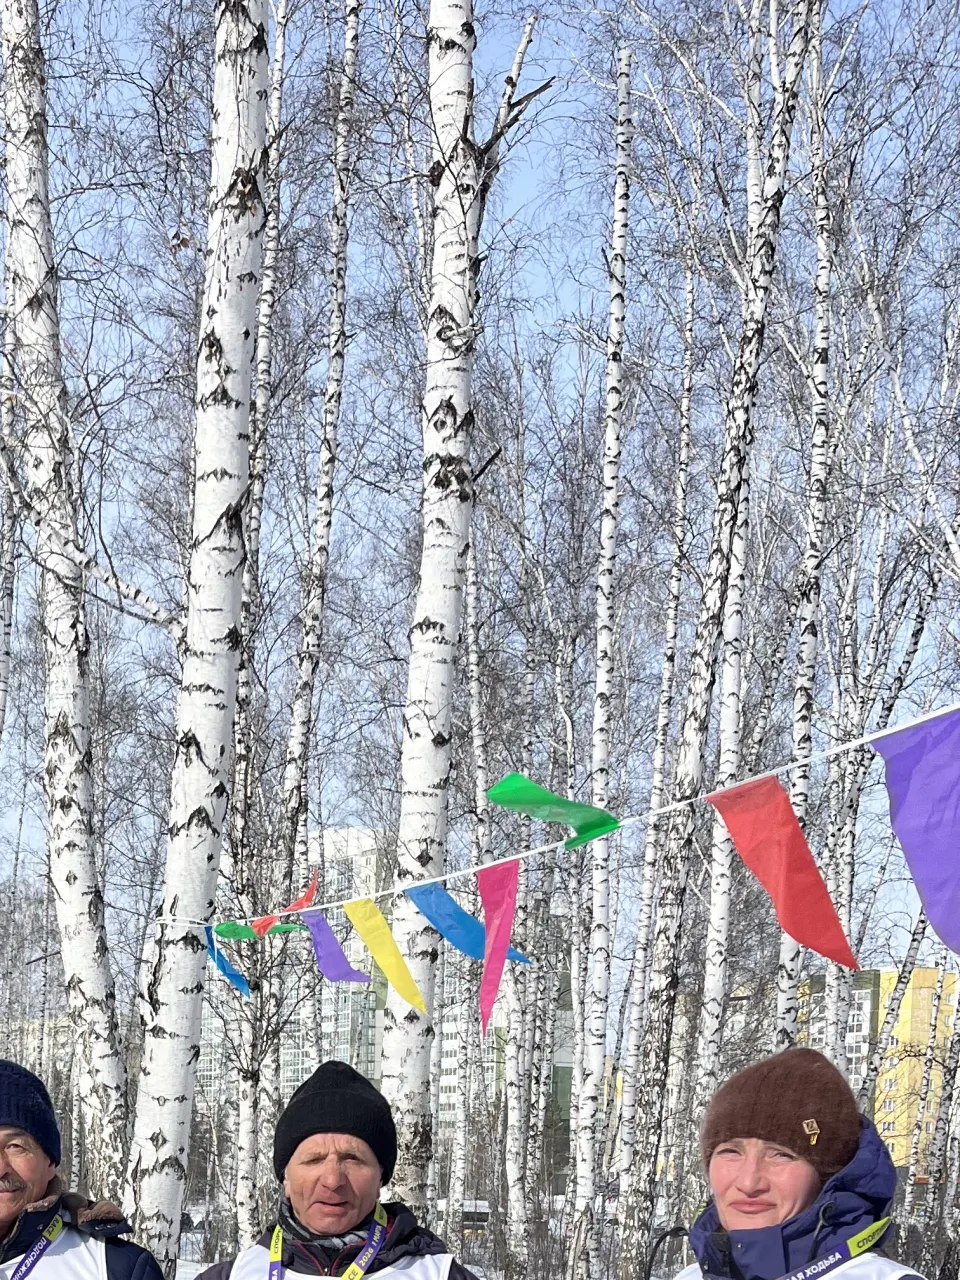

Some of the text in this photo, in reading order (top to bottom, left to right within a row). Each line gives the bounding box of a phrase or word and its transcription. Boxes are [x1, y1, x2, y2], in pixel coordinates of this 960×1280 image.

[45, 1217, 60, 1237] RACE
[358, 1246, 375, 1267] 2026
[804, 1251, 843, 1278] ХОДЬБА
